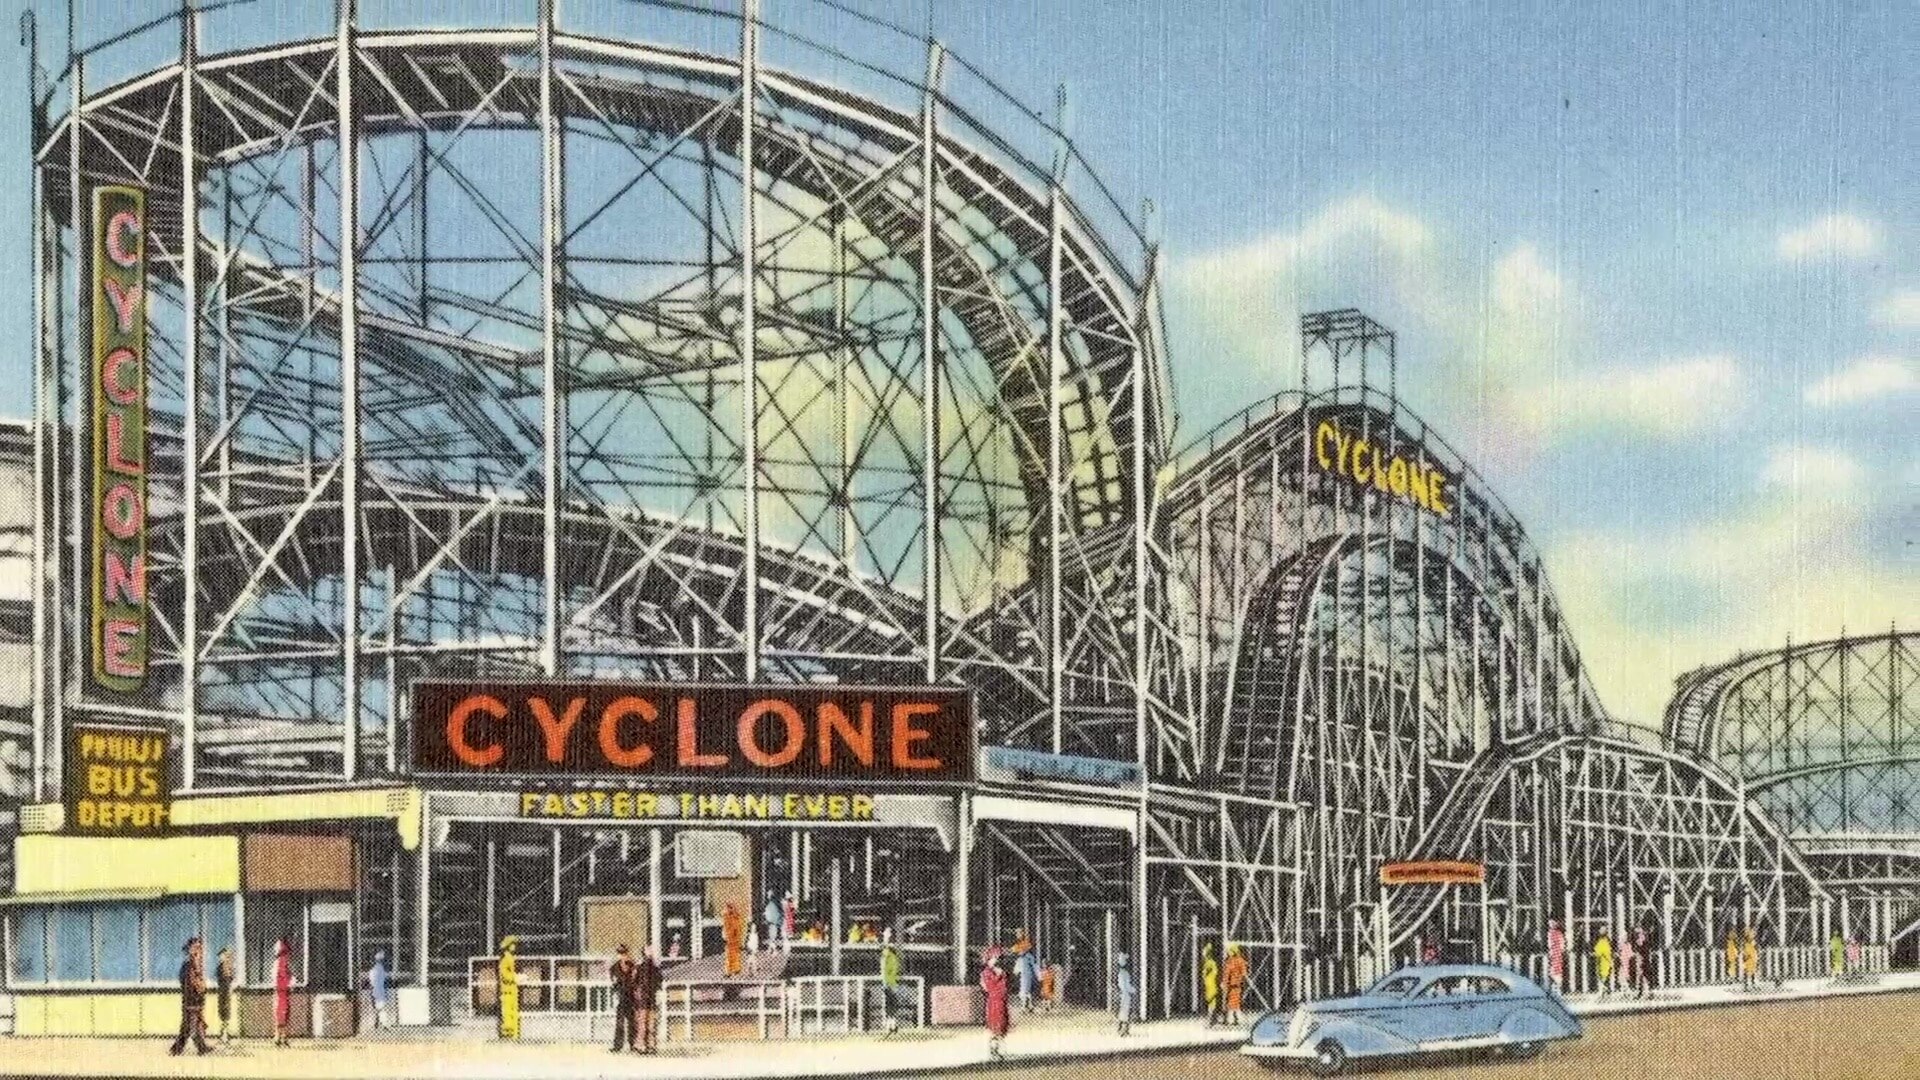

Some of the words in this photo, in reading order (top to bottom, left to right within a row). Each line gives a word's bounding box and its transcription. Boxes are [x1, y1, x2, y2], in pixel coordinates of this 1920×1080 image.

[103, 211, 146, 677] CYCLONE
[1316, 420, 1450, 515] CYCLONE
[446, 694, 944, 768] CYCLONE
[89, 765, 158, 796] BUS
[521, 793, 659, 819] FASTER
[680, 793, 770, 819] THAN
[783, 793, 876, 819] EVER
[78, 800, 168, 827] DEPOT
